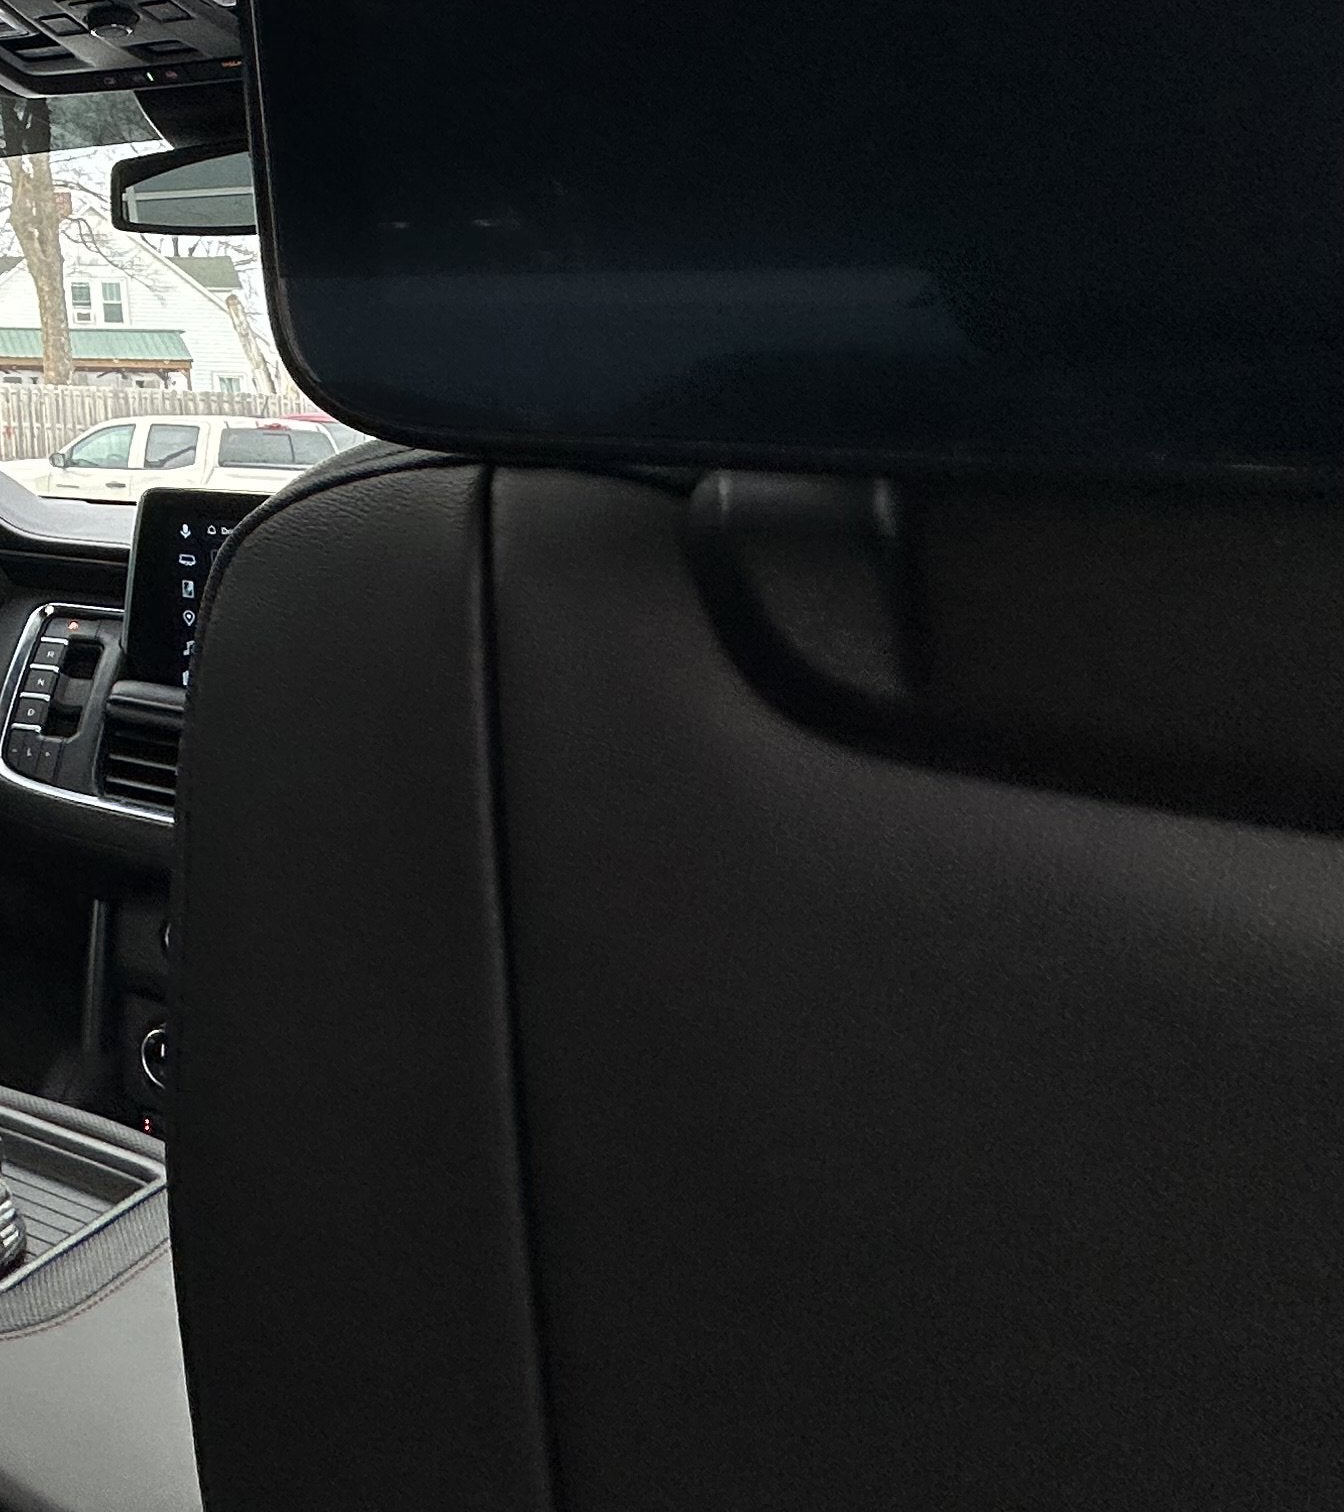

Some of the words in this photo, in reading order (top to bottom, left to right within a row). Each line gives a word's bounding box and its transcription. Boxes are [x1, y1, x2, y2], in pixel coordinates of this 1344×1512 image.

[46, 650, 55, 658] R
[37, 679, 45, 687] N
[27, 708, 36, 717] D
